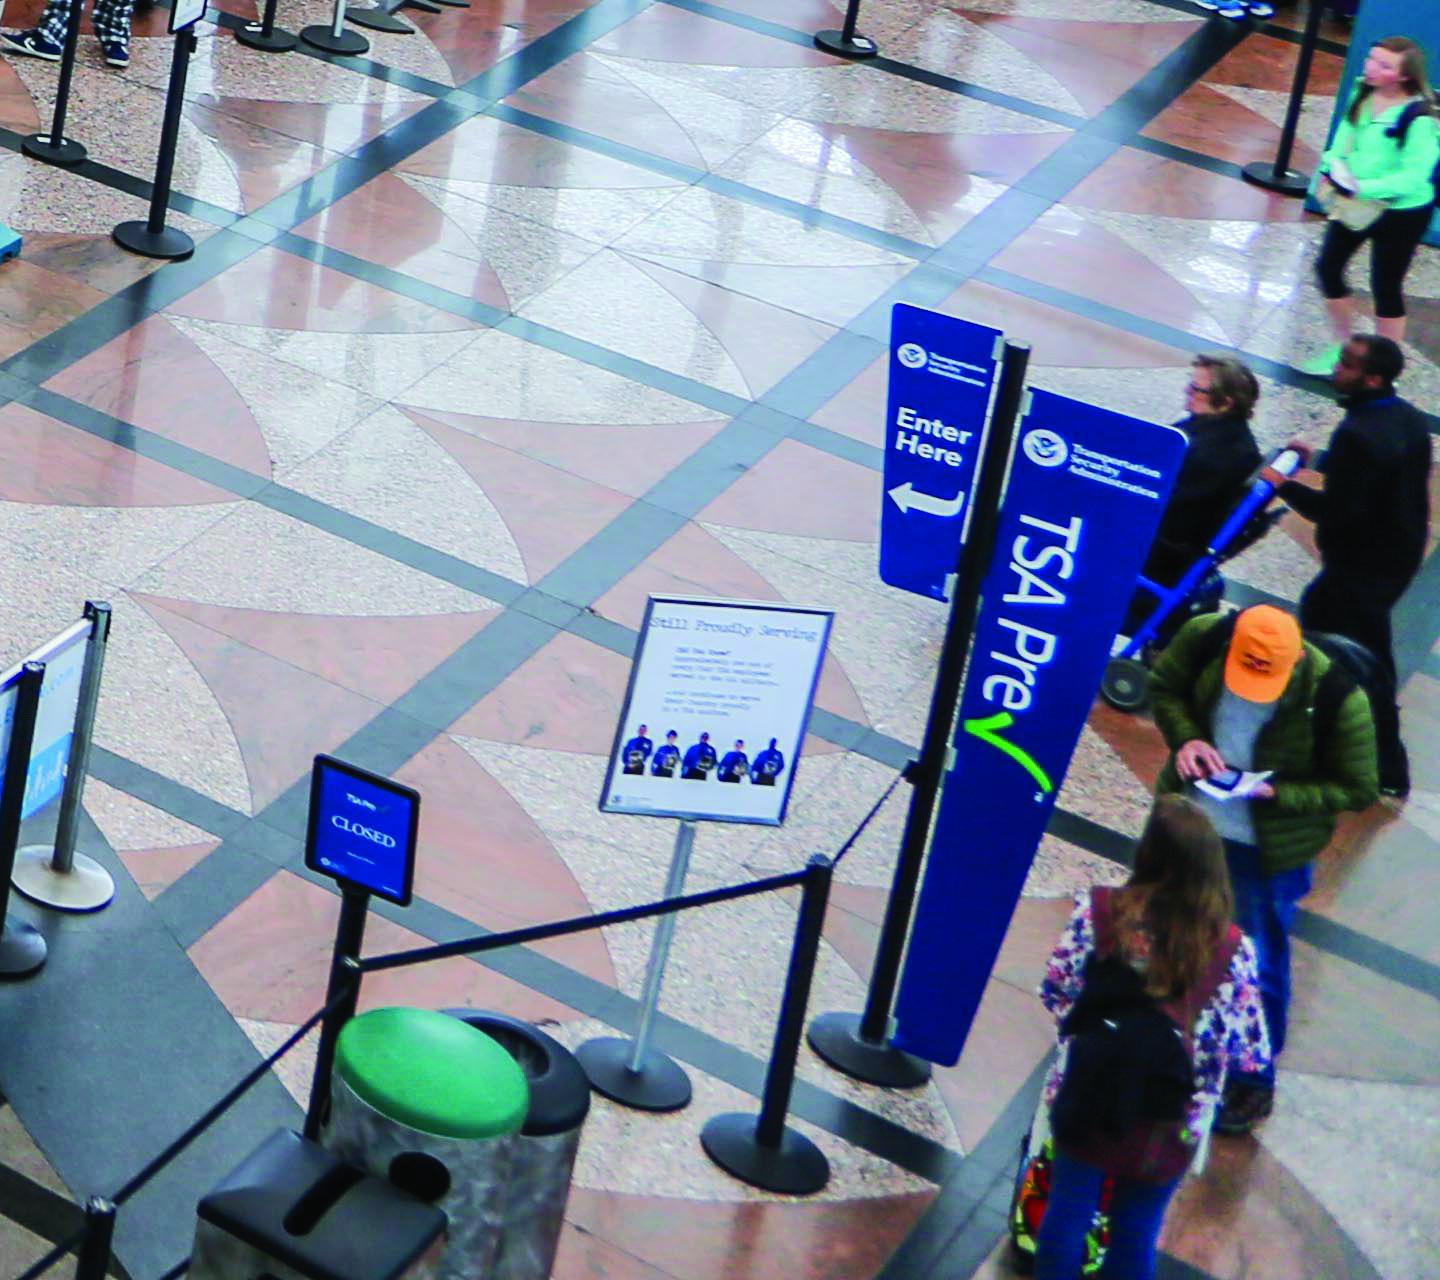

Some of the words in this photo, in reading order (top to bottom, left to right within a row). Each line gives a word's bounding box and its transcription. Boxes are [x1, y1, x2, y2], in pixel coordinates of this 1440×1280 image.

[896, 405, 973, 446] Enter
[894, 430, 963, 468] Here
[1070, 452, 1120, 480] Security
[1071, 441, 1163, 480] Transportation
[1068, 462, 1161, 500] Administration
[1001, 512, 1083, 607] TSA
[649, 614, 689, 631] Still
[694, 618, 755, 637] Proudly
[758, 623, 818, 643] Serving
[981, 616, 1058, 712] Pre
[331, 814, 397, 848] CLOSED
